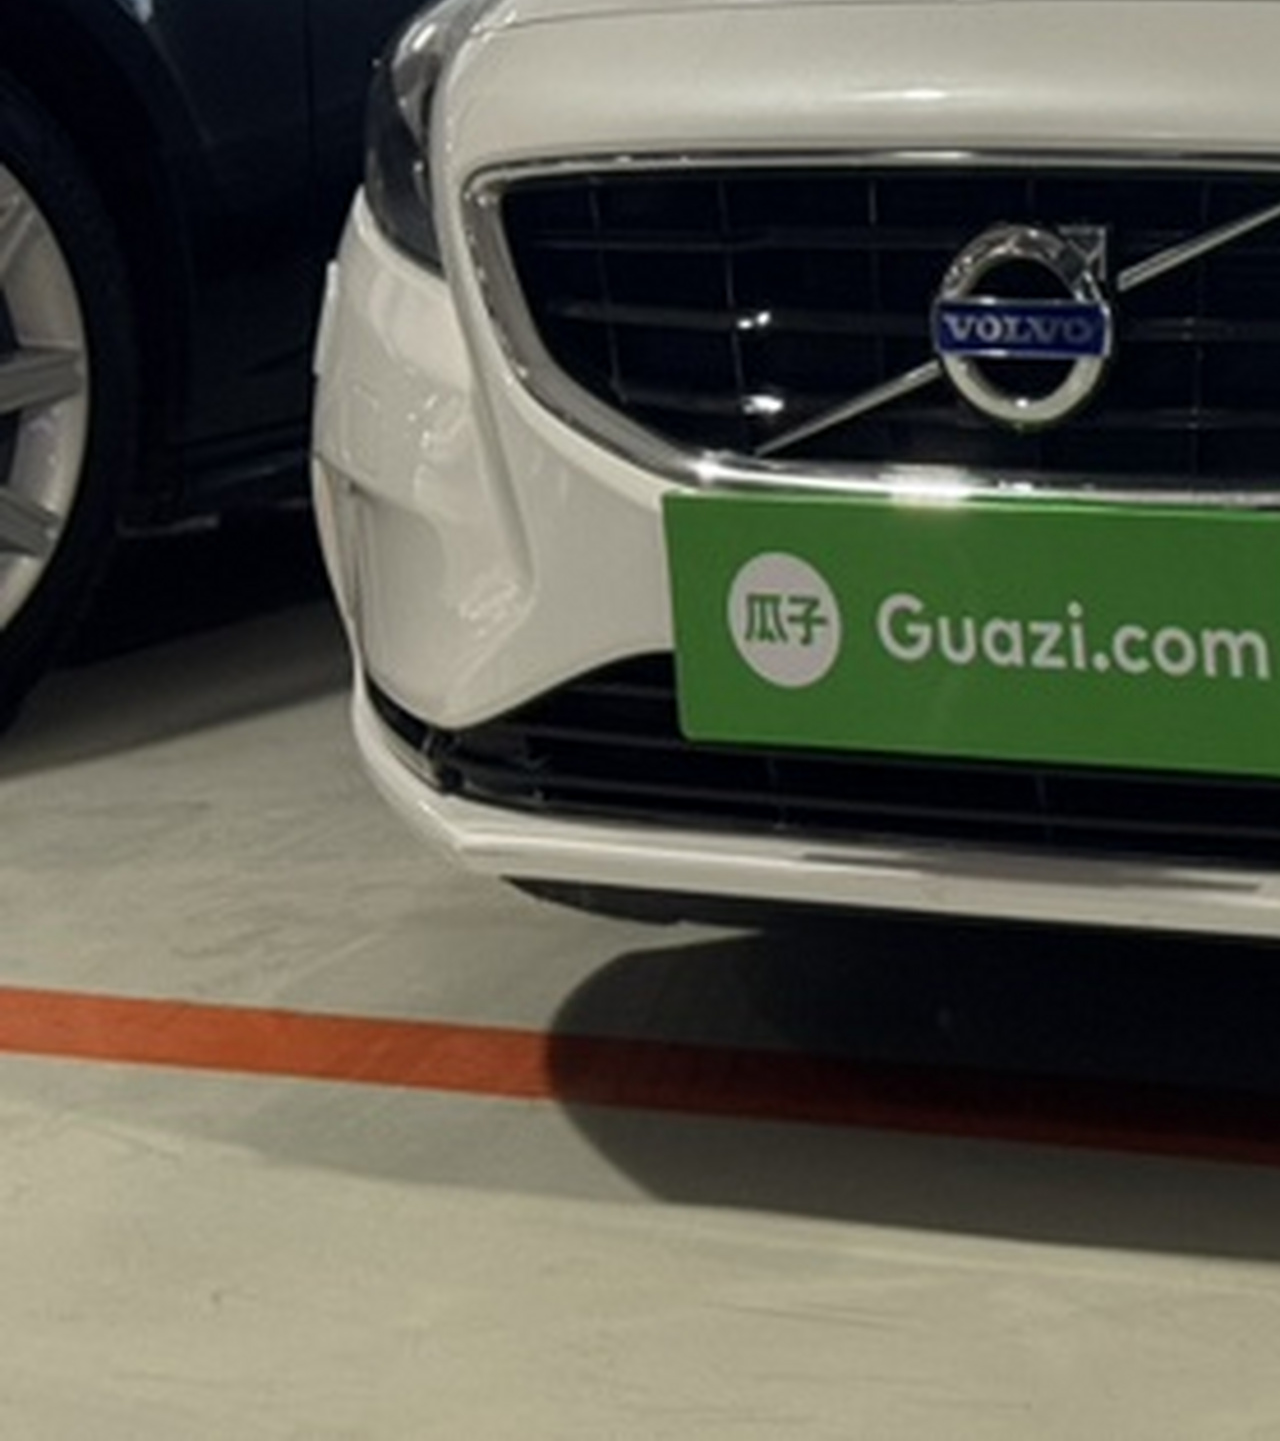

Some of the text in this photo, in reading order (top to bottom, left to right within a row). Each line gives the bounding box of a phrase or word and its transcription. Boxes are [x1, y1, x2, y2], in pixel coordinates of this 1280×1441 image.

[942, 313, 1093, 344] VOLVO
[744, 593, 829, 646] 瓜子
[877, 593, 1269, 679] Guazi.com
